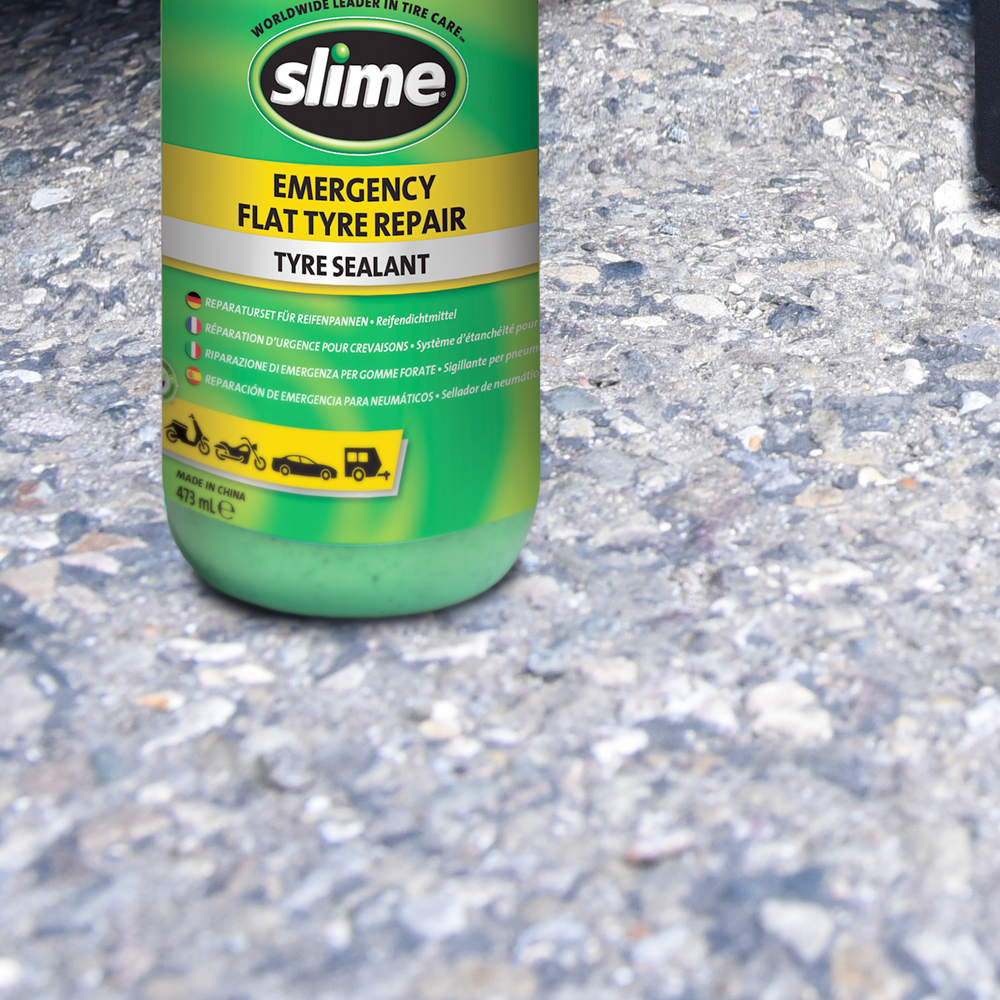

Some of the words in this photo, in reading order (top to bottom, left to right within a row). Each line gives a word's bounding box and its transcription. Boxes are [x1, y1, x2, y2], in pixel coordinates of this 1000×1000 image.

[384, 0, 398, 12] IN
[402, 1, 429, 20] TIRE
[270, 43, 446, 108] slime
[273, 173, 436, 203] EMERGENCY
[238, 203, 298, 234] FLAT
[303, 210, 368, 237] TYRE
[375, 206, 467, 237] REPAIR
[274, 251, 327, 276] TYRE
[332, 253, 430, 277] SEALANT
[205, 297, 277, 321] REPARATURSET
[277, 309, 296, 323] FÜR
[297, 314, 368, 327] REIFENPANNEN
[376, 309, 458, 328] Reifendichtmittel
[205, 322, 265, 345] RÉPARATION
[322, 341, 349, 353] POUR
[350, 341, 409, 353] CREVAISONS
[416, 335, 455, 352] Système
[515, 320, 538, 335] pour
[205, 348, 269, 373] RIPARAZIONE
[270, 361, 280, 373] DI
[280, 363, 339, 380] EMERGENZA
[341, 368, 358, 380] PER
[359, 367, 399, 380] GOMME
[400, 364, 436, 378] FORATE
[443, 355, 488, 375] Sigillante
[489, 353, 505, 368] per
[505, 345, 540, 363] pneum
[205, 373, 266, 398] REPARACIÓN
[267, 387, 279, 400] DE
[280, 390, 342, 406] EMERGENCIA
[343, 395, 369, 407] PARA
[370, 390, 434, 407] NEUMÁTICOS
[441, 384, 480, 400] Sellador
[480, 381, 493, 392] de
[176, 470, 203, 488] MADE
[205, 481, 215, 492] IN
[217, 485, 246, 502] CHINA
[176, 486, 196, 506] 473
[198, 497, 216, 514] mL
